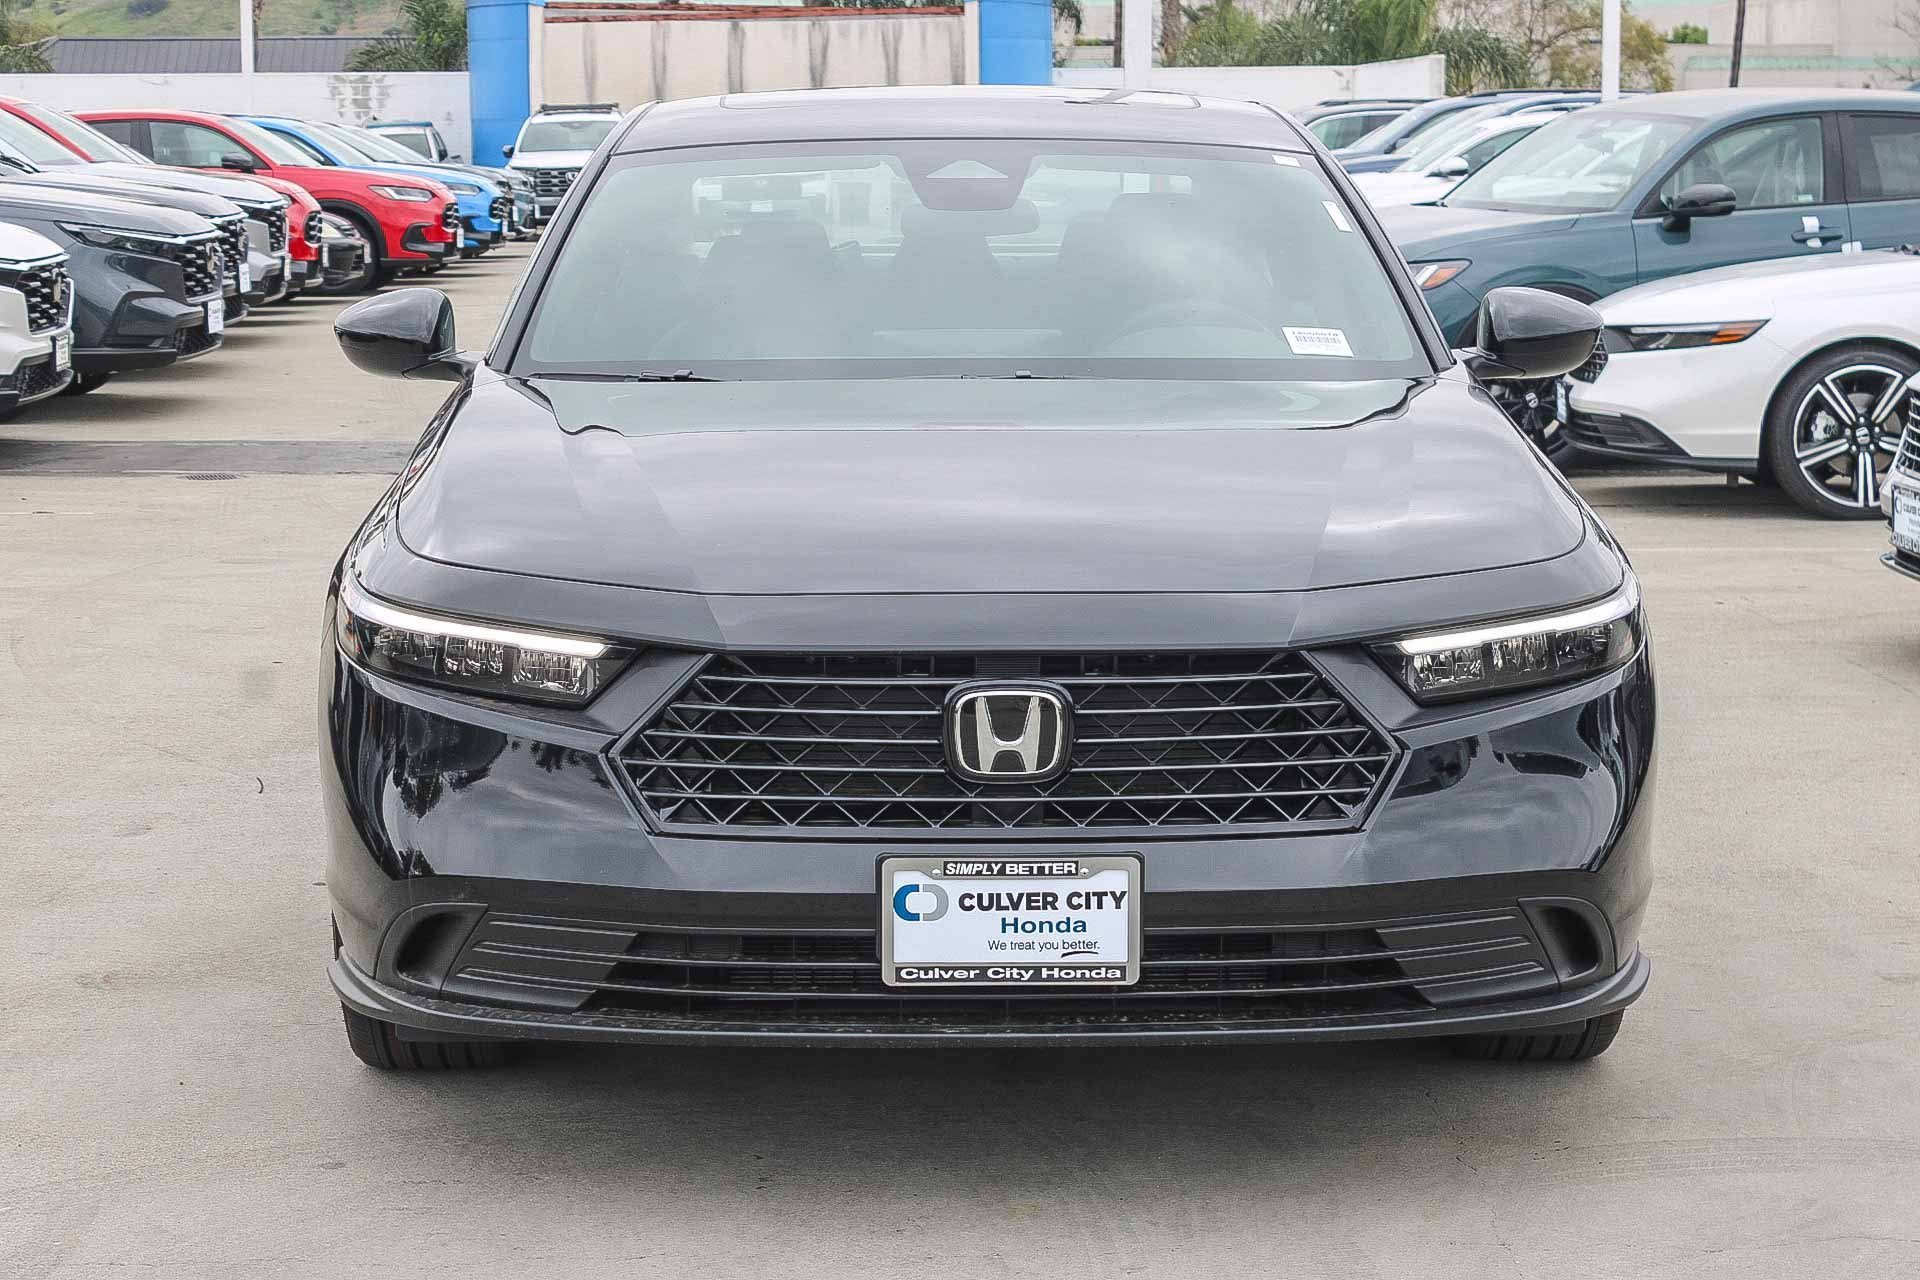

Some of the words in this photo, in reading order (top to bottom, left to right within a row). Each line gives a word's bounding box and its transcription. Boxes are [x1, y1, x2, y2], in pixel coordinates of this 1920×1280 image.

[945, 862, 1001, 875] SIMPLY
[1005, 862, 1077, 875] BETTER
[958, 892, 1059, 912] CULVER
[1066, 890, 1128, 911] CITY
[1000, 916, 1087, 934] Honda
[988, 940, 1007, 951] We
[1010, 940, 1035, 951] treat
[1039, 941, 1059, 953] you
[1062, 939, 1101, 951] better.
[899, 967, 980, 980] Culver
[986, 967, 1033, 981] City
[1041, 967, 1122, 979] Honda
